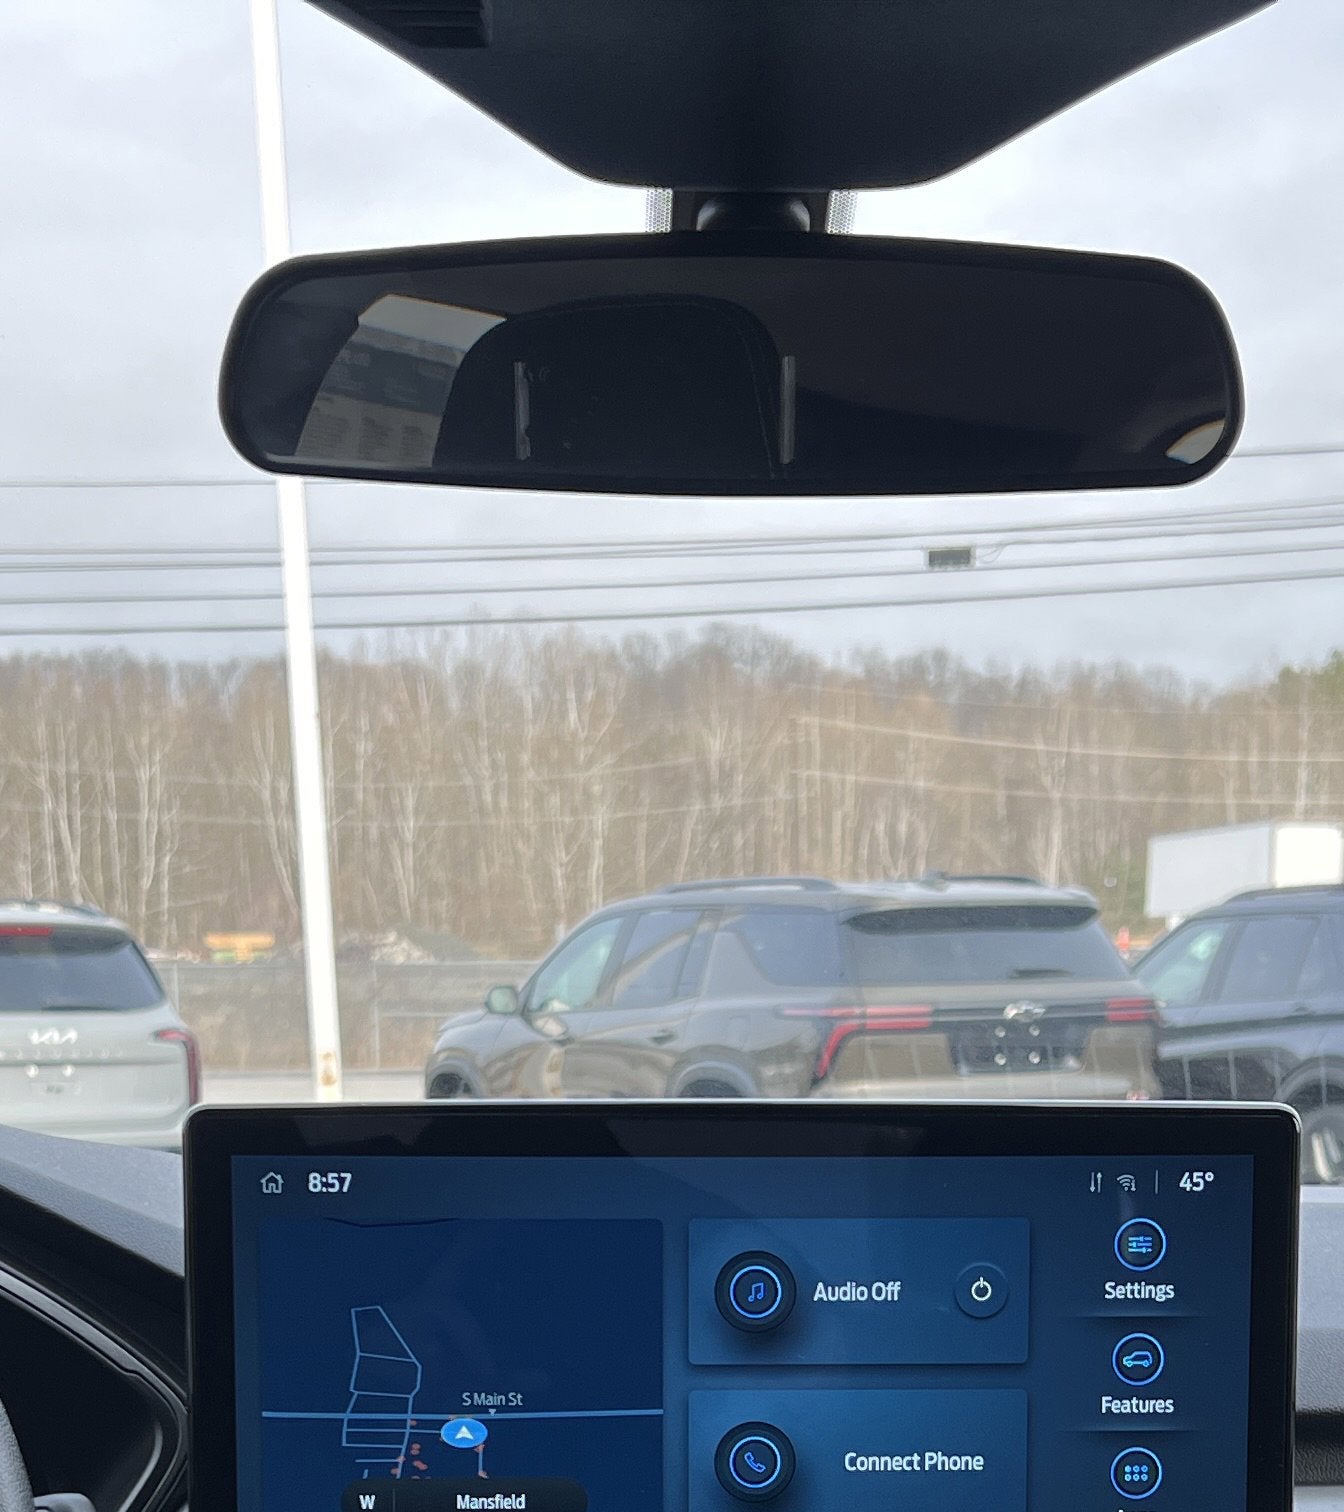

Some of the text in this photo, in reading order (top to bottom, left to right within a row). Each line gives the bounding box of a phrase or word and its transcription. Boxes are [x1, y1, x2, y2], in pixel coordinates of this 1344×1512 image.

[308, 1172, 352, 1193] 8:57
[1179, 1171, 1215, 1192] 45°
[813, 1280, 902, 1302] Audio Off
[1104, 1281, 1175, 1302] Settings
[462, 1391, 523, 1406] S Main St
[1101, 1396, 1175, 1414] Features
[844, 1451, 984, 1472] Connect Phone
[358, 1494, 376, 1510] W
[456, 1493, 526, 1510] Mansfield
